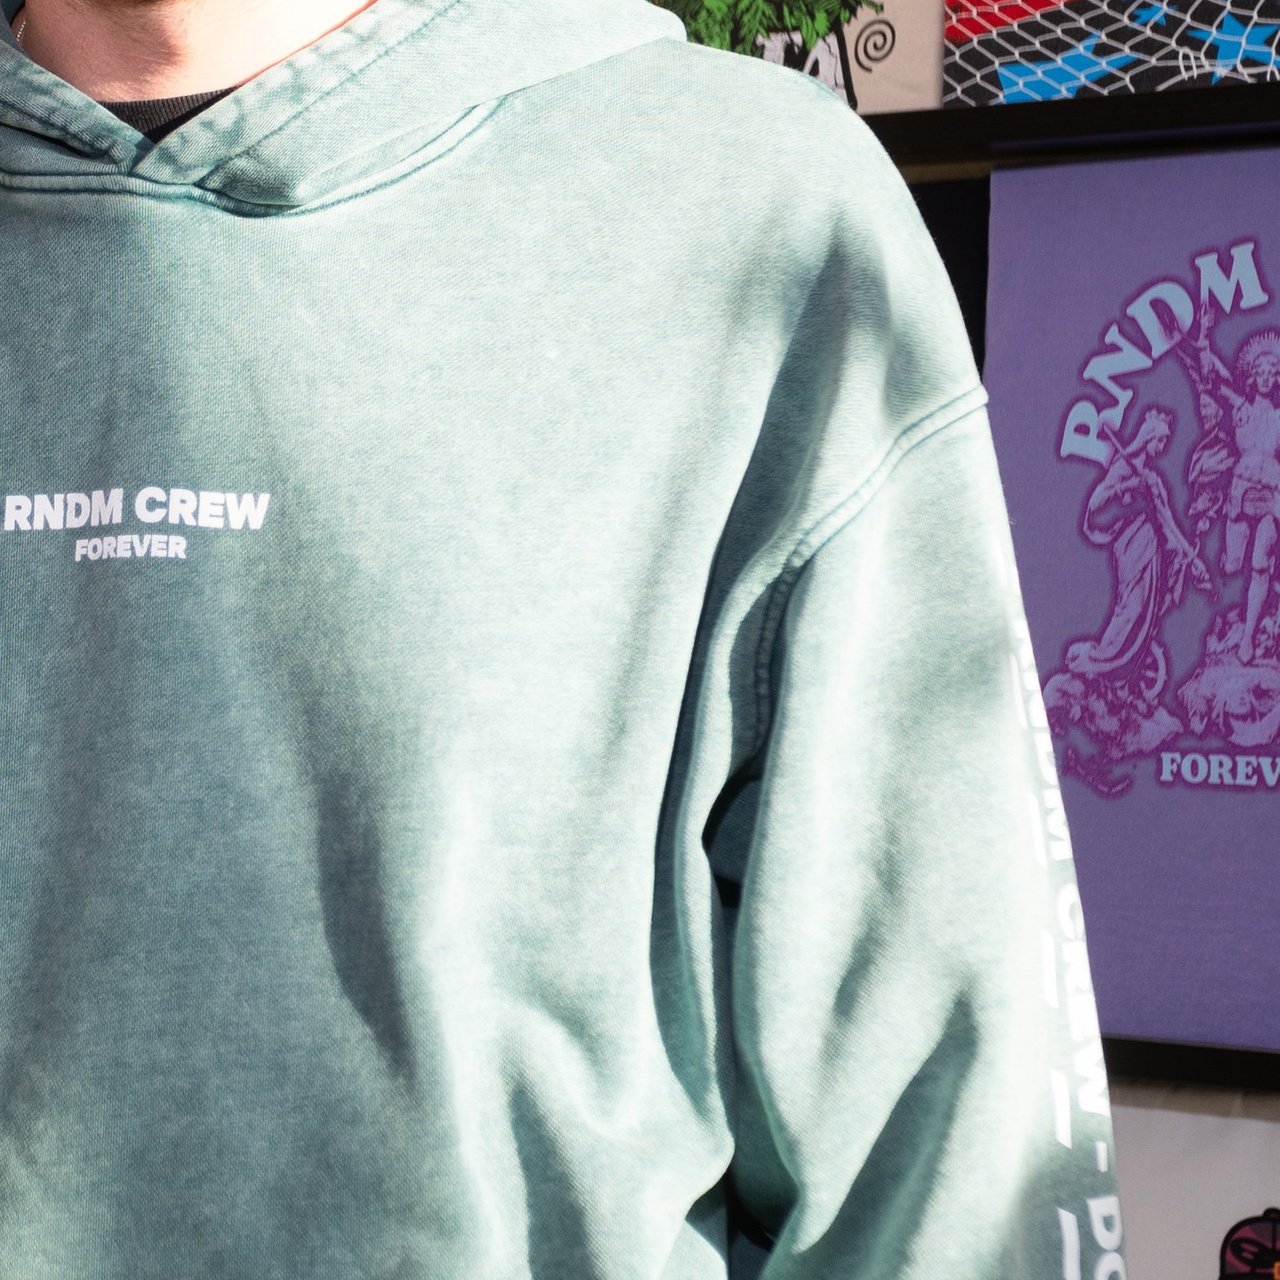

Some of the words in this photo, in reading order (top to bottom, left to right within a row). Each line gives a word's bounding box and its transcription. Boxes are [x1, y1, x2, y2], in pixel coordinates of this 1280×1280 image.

[1060, 241, 1269, 468] RNDM
[4, 488, 124, 531] RNDM
[134, 486, 271, 530] CREW
[74, 534, 187, 562] FOREVER
